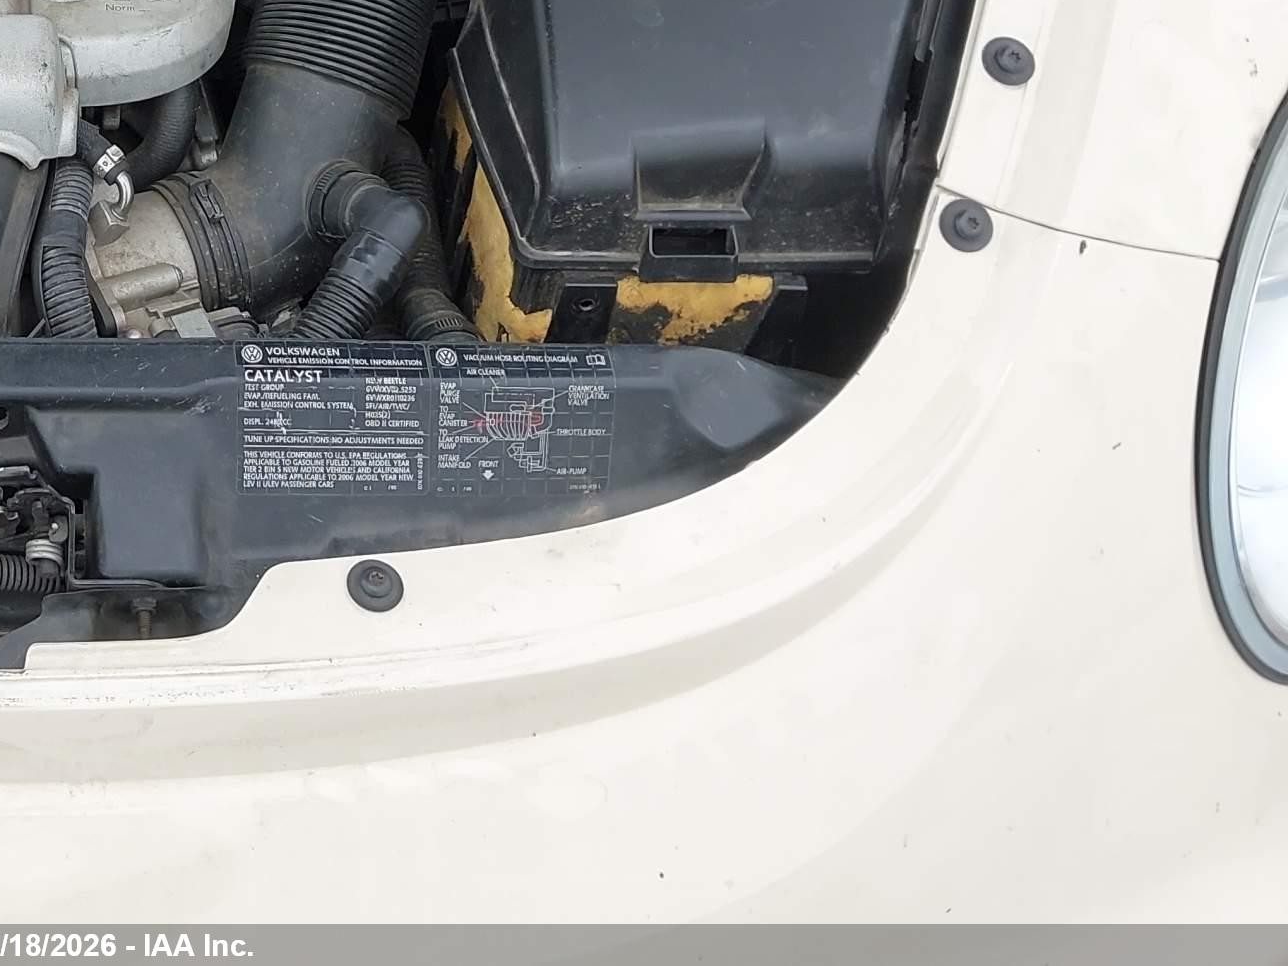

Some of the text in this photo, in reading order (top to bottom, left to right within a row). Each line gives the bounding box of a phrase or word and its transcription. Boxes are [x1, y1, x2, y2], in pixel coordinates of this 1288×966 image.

[105, 3, 135, 12] Norm
[266, 347, 340, 356] VOLKSWAGEN
[244, 370, 322, 382] CATALYST
